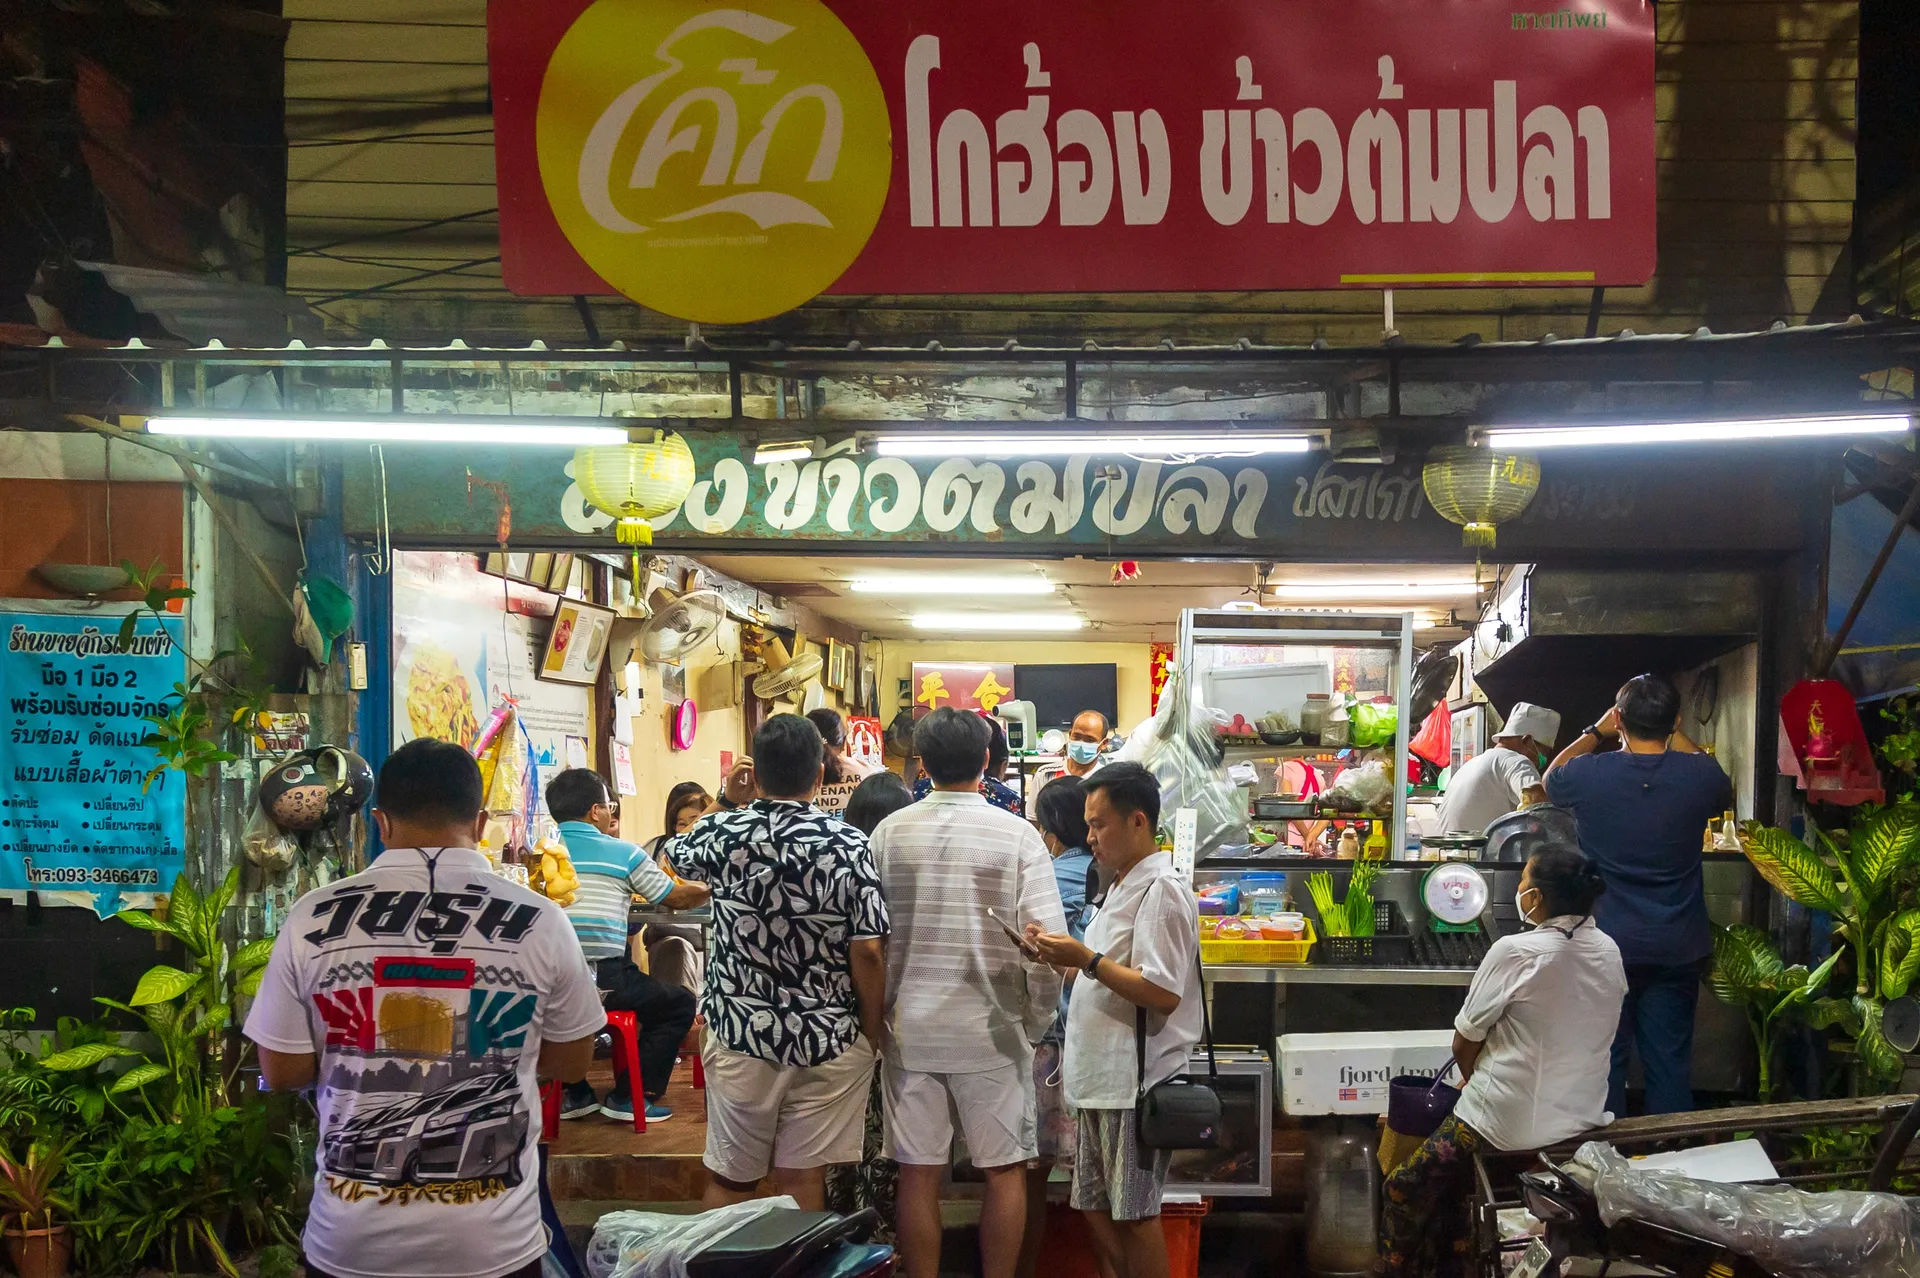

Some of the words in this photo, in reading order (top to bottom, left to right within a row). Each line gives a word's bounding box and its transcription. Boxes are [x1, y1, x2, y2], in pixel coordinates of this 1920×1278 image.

[1200, 54, 1611, 226] ข้าวต้มปลา
[764, 435, 1268, 538] ข้าวตมปลา
[9, 624, 172, 658] ร้านขายจักรเบผ้า
[74, 669, 83, 686] 1
[91, 663, 119, 687] มือ
[124, 669, 137, 688] 2
[10, 719, 79, 744] รับซ่อม
[1340, 1065, 1391, 1087] fjord
